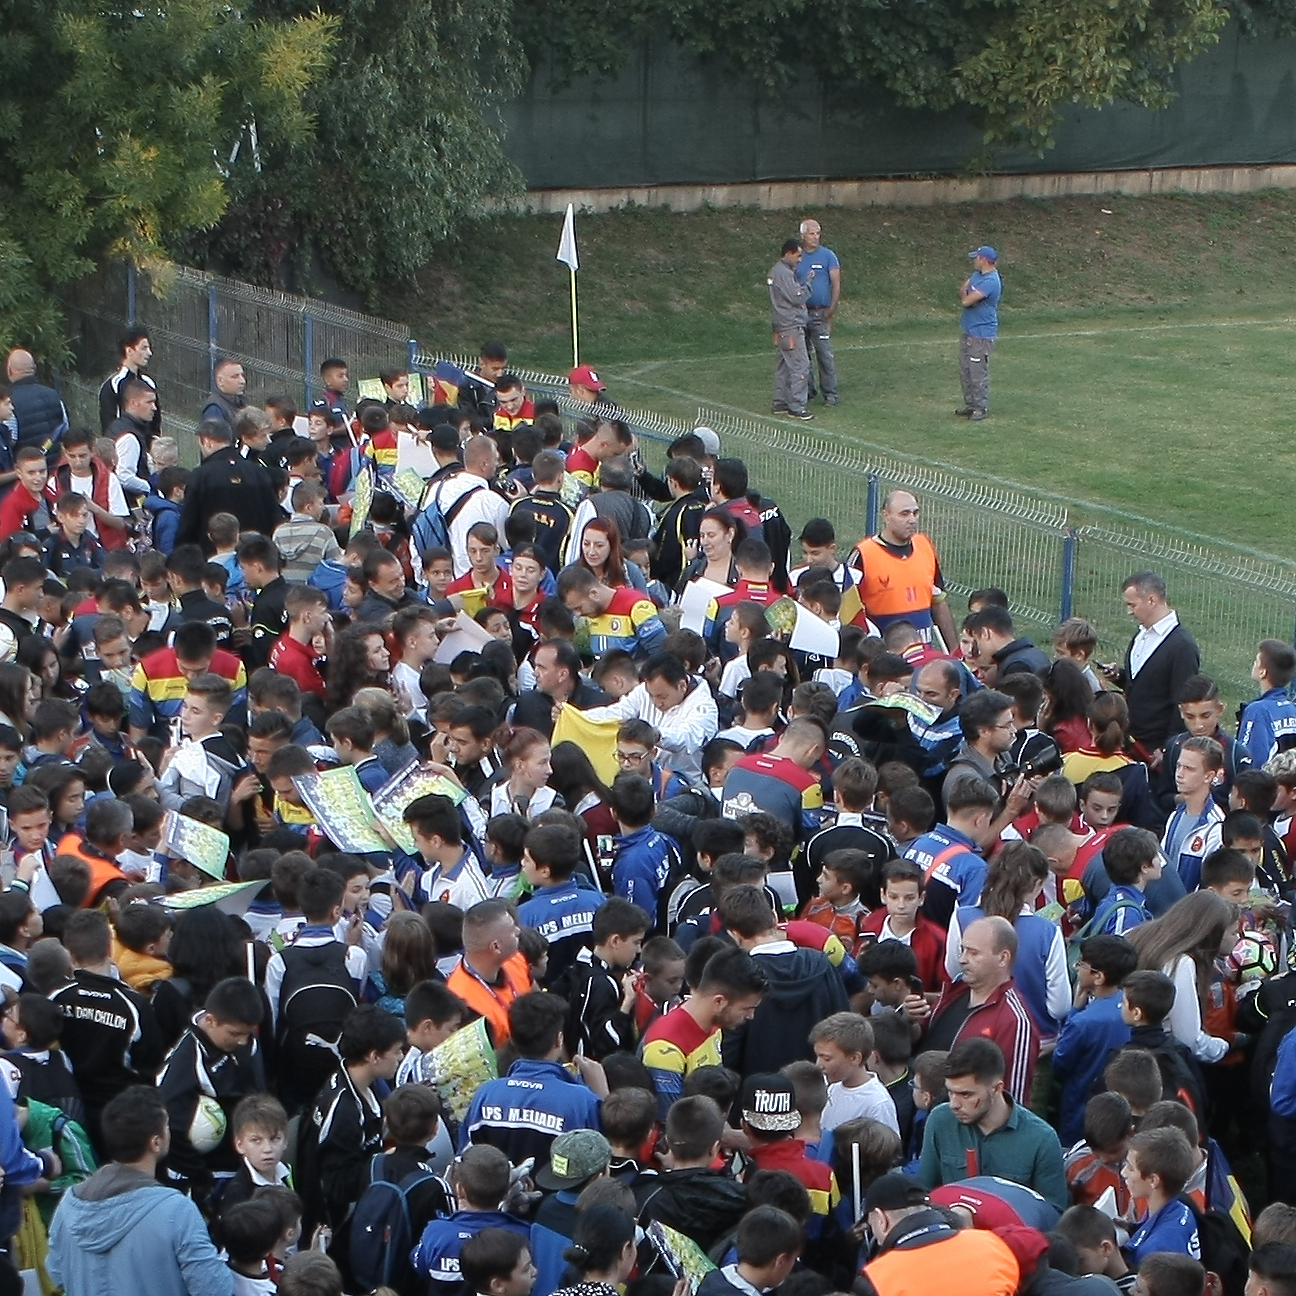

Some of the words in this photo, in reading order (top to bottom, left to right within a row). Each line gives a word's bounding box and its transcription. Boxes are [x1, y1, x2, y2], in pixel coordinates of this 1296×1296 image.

[76, 1005, 94, 1020] DAN
[753, 1089, 791, 1112] TRUTH
[481, 1106, 503, 1122] LPS
[508, 1108, 565, 1132] M.ELIADE
[440, 1257, 461, 1272] LPS
